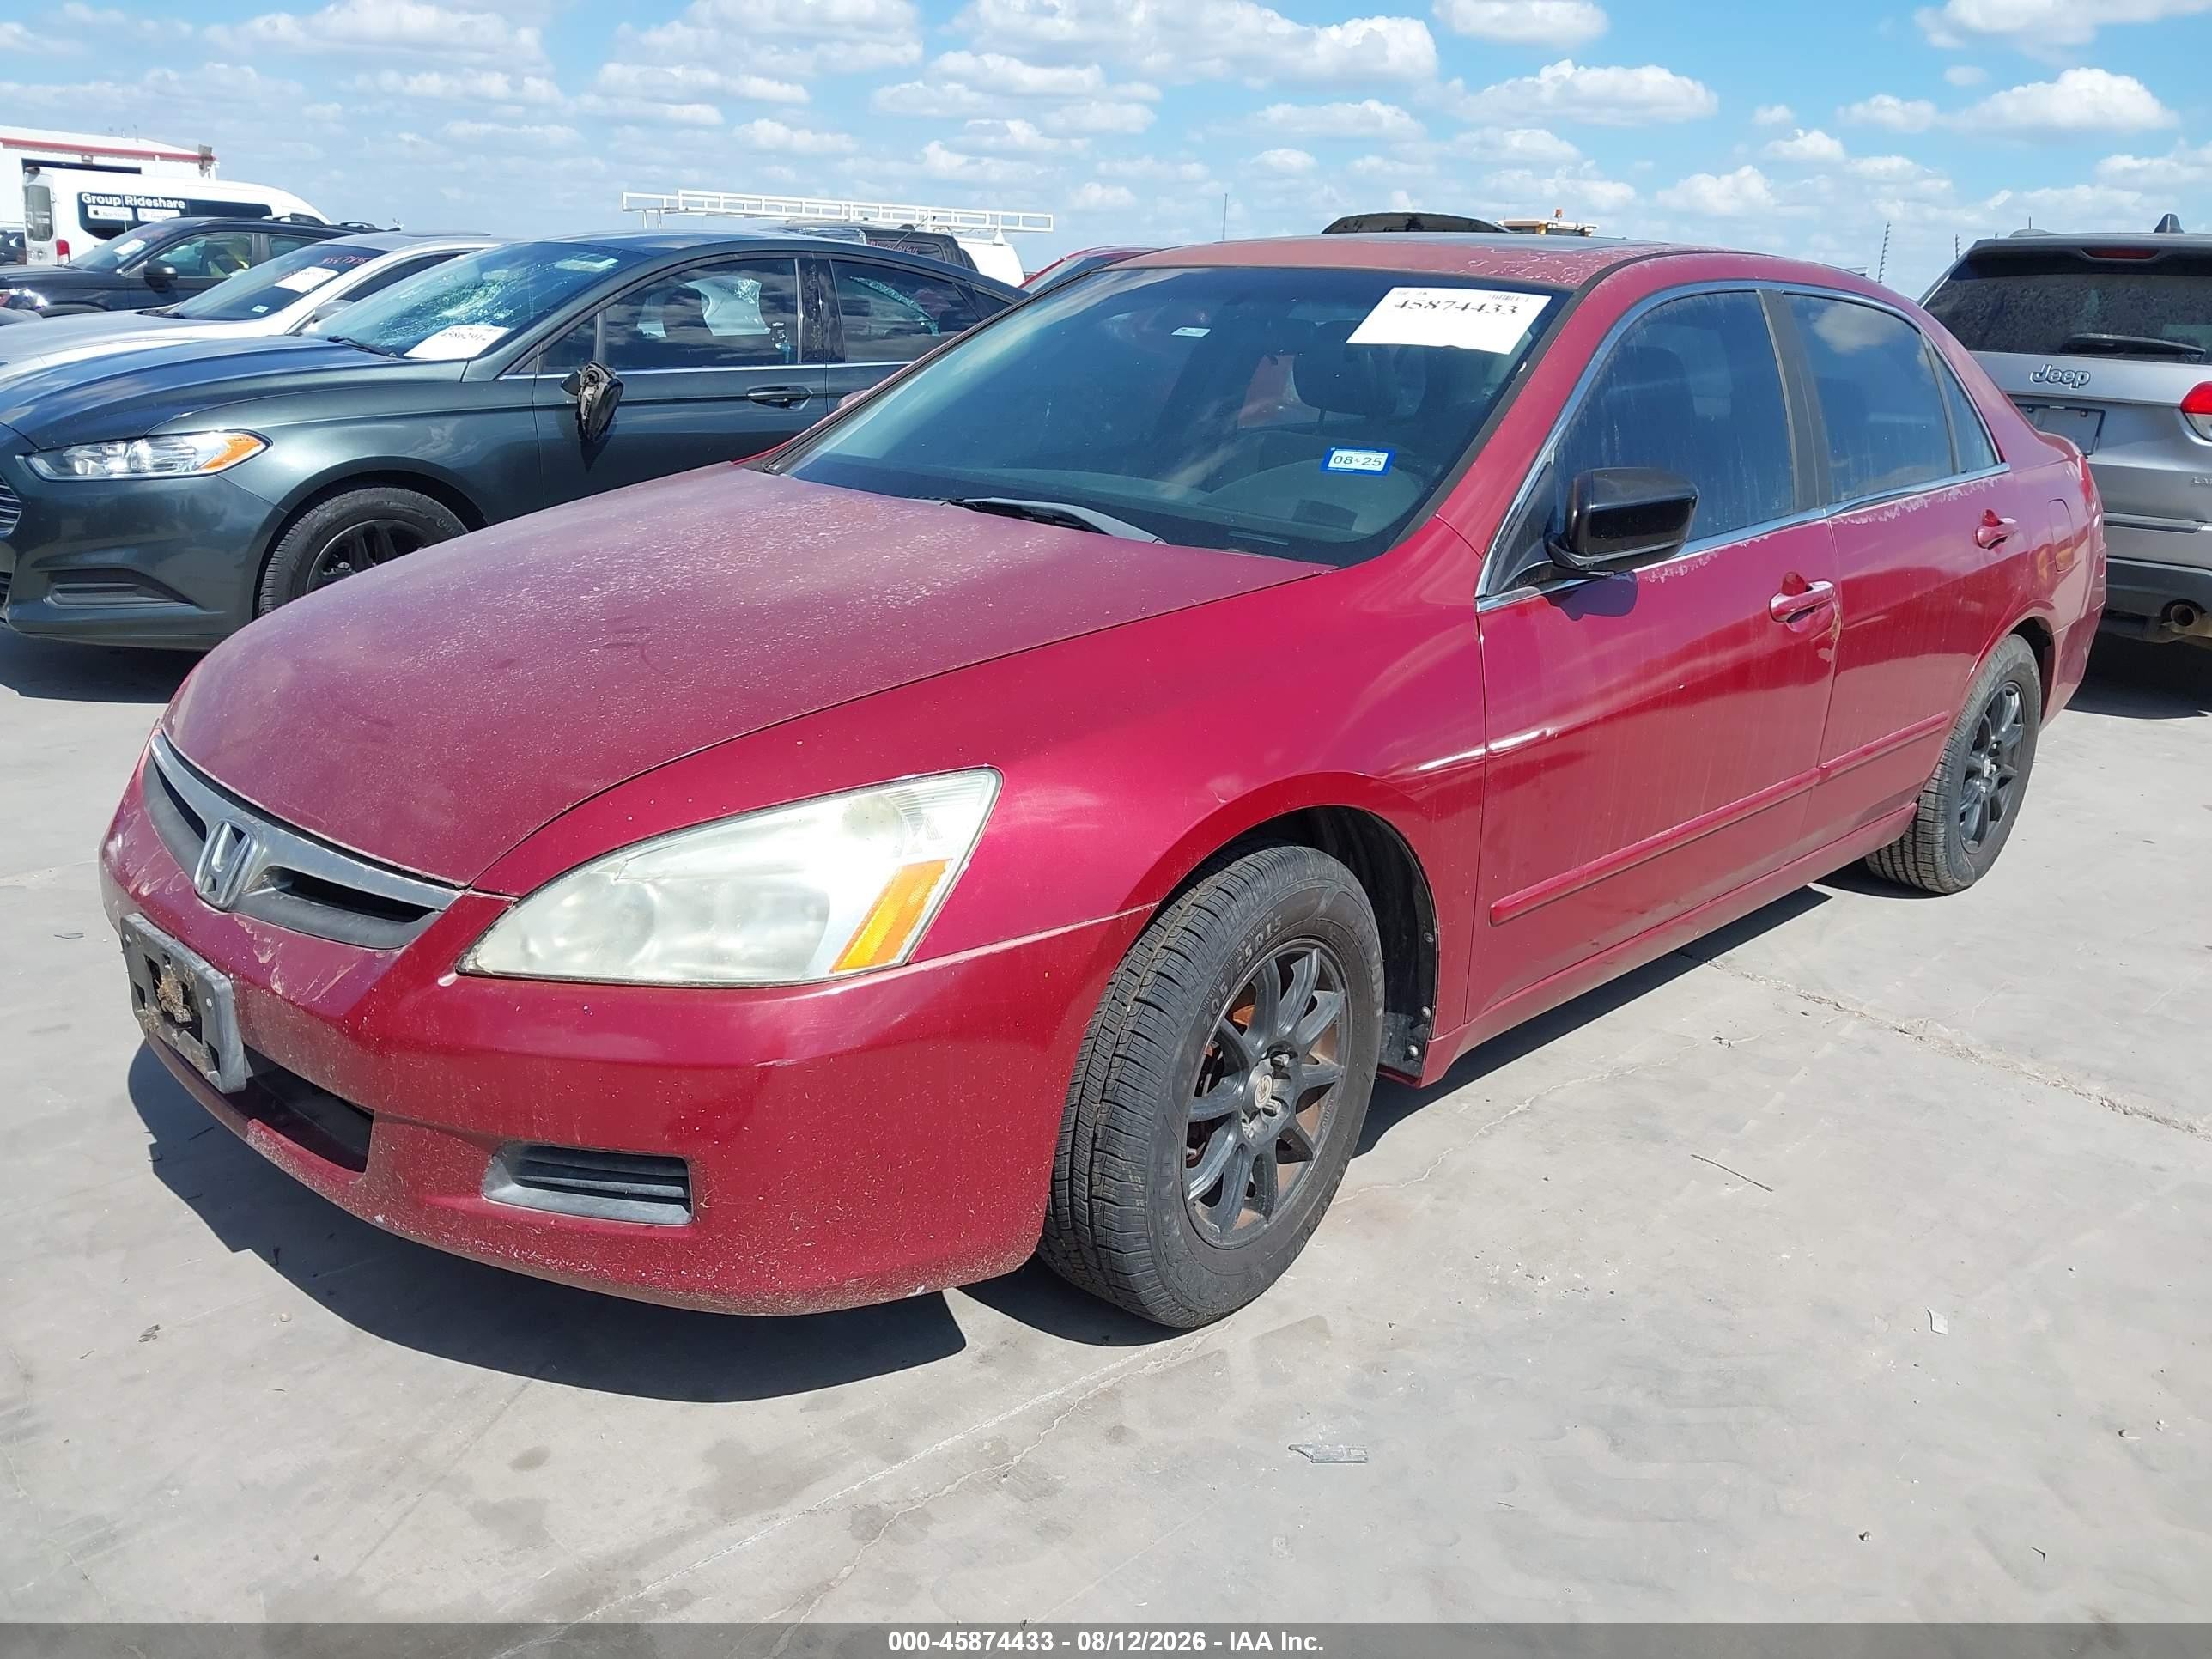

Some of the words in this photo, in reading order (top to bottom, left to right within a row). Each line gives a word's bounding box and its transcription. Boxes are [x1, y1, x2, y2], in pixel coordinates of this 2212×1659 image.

[81, 193, 122, 206] Group
[124, 195, 186, 209] Rideshare
[1394, 299, 1519, 315] 45874433
[2029, 364, 2091, 390] Jeep
